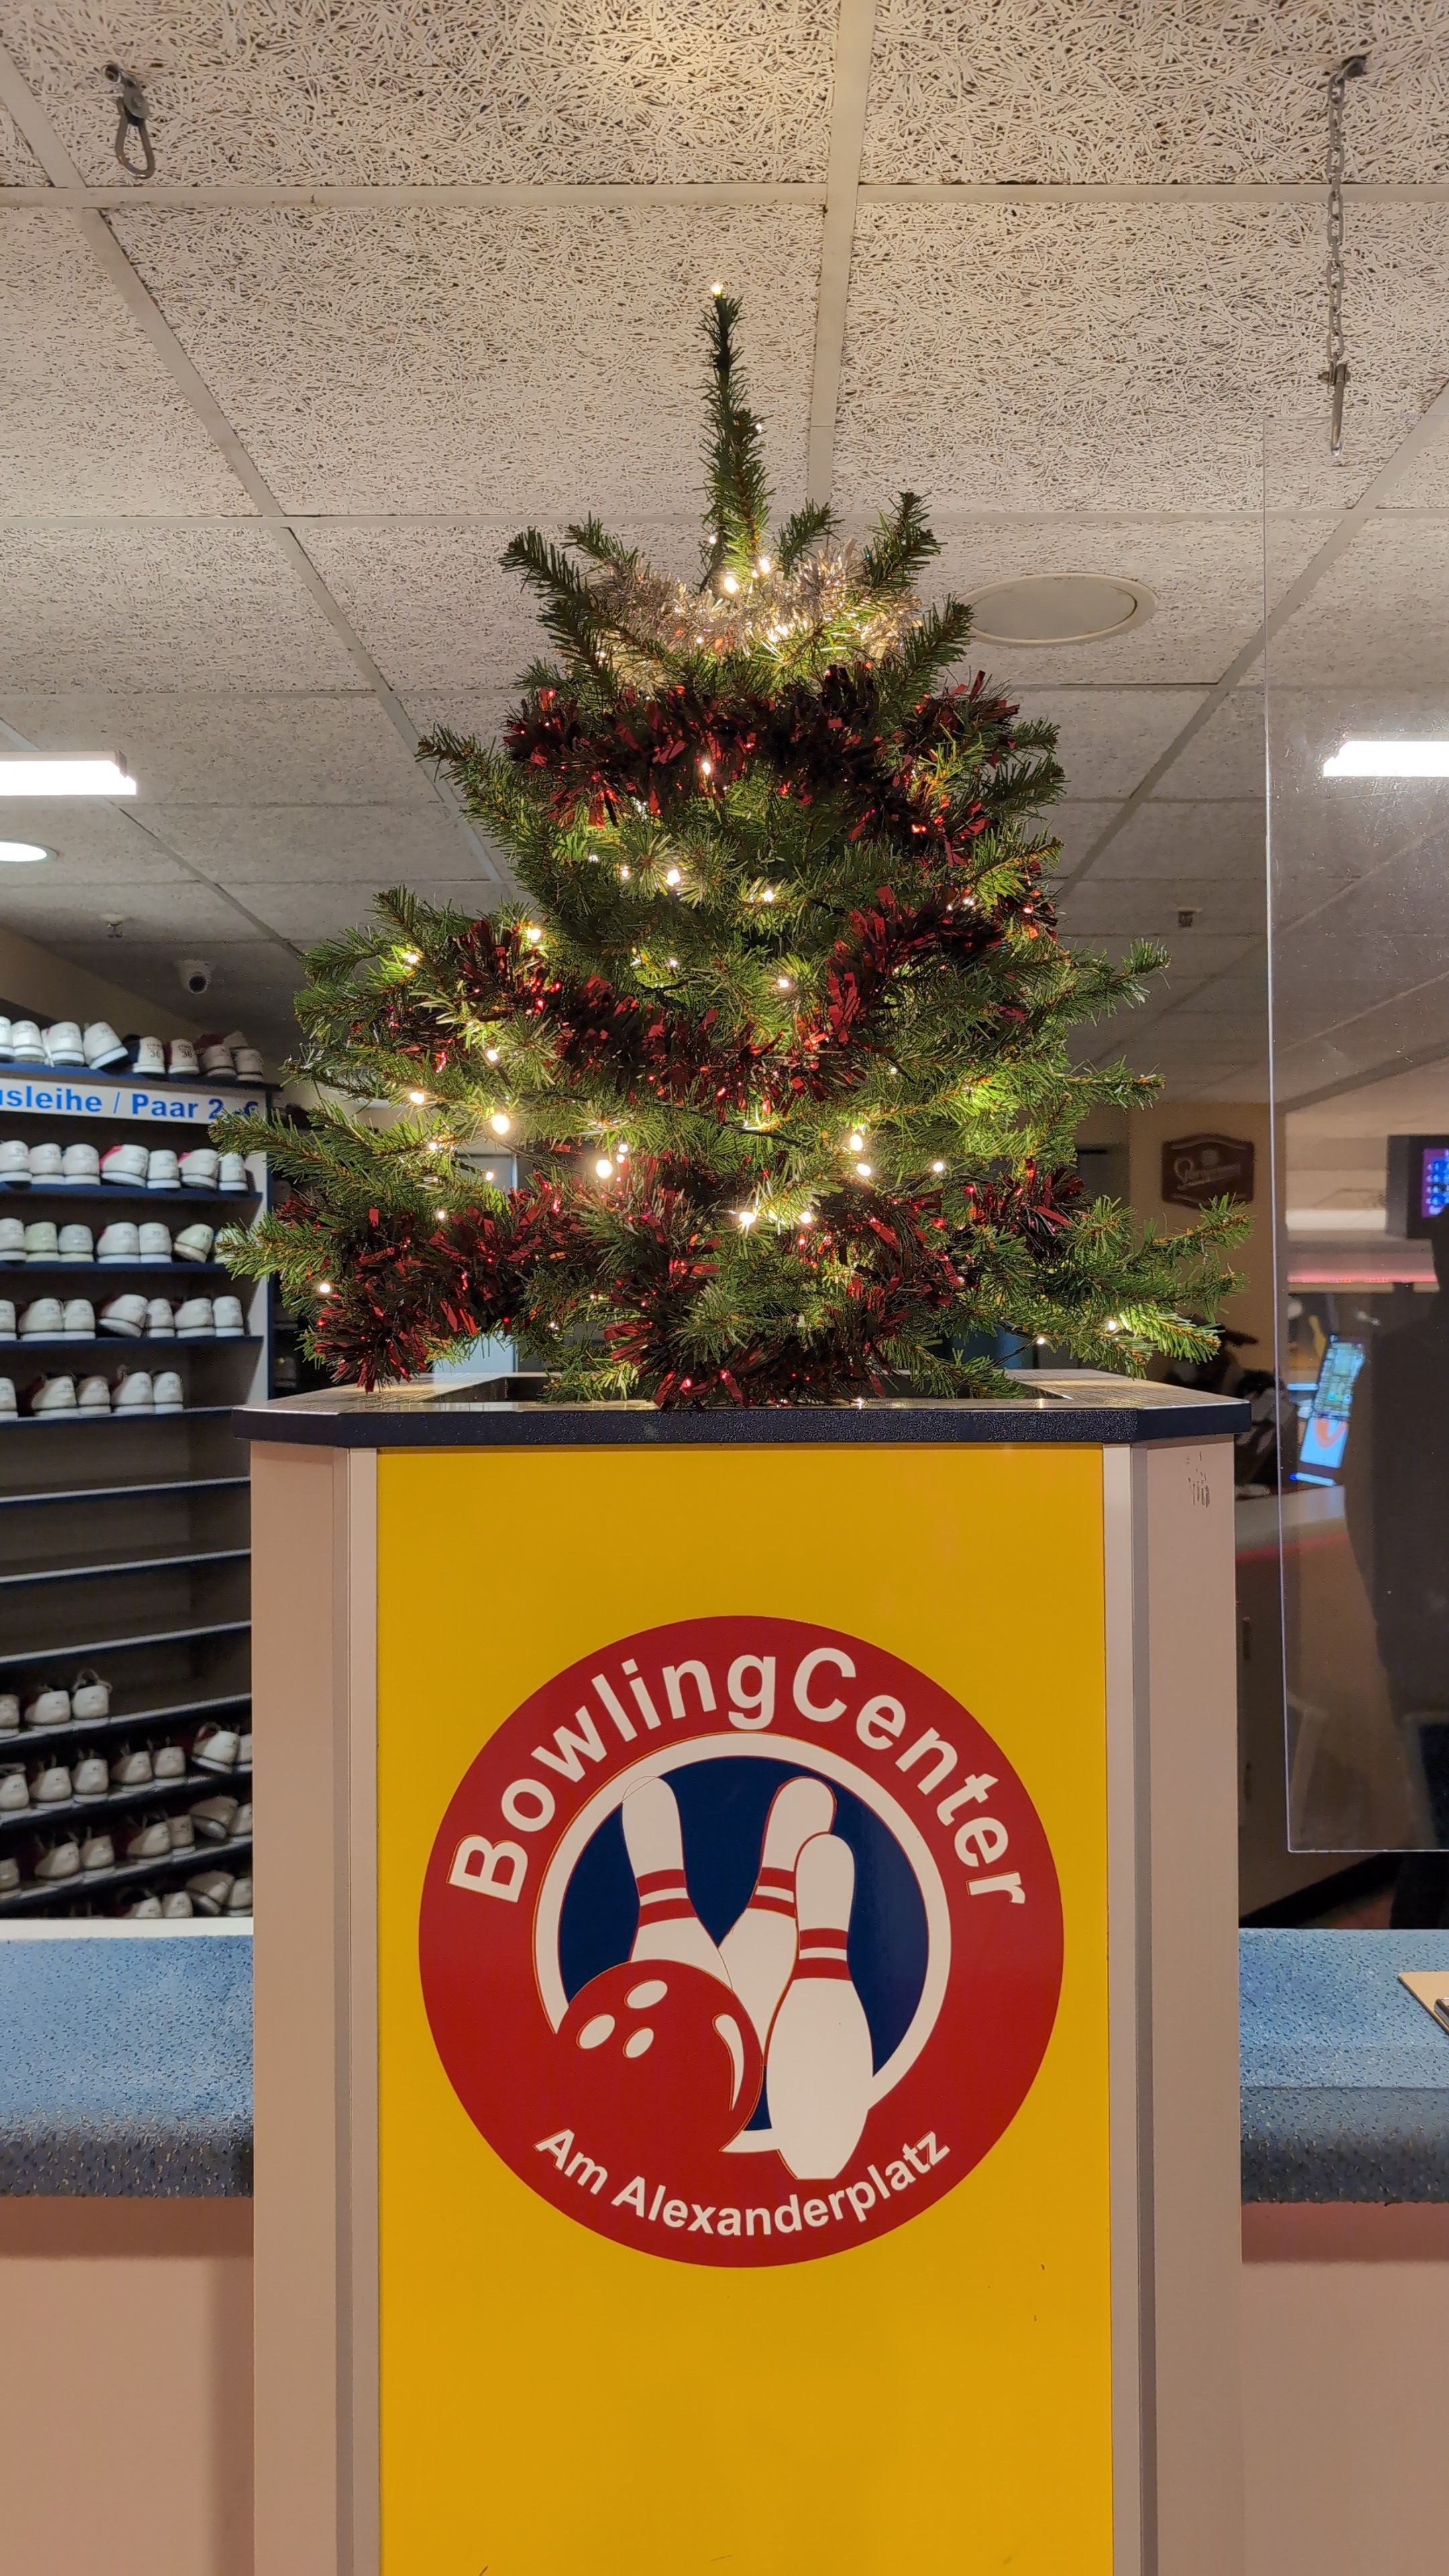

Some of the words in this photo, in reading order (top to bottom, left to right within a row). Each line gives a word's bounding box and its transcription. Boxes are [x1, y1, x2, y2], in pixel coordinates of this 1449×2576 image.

[0, 1085, 103, 1114] sleihe
[113, 1091, 121, 1114] /
[131, 1093, 199, 1120] Paar
[447, 1647, 1026, 1905] BowlingCenter
[535, 2129, 608, 2195] Am
[610, 2131, 951, 2236] Alexanderplatz
